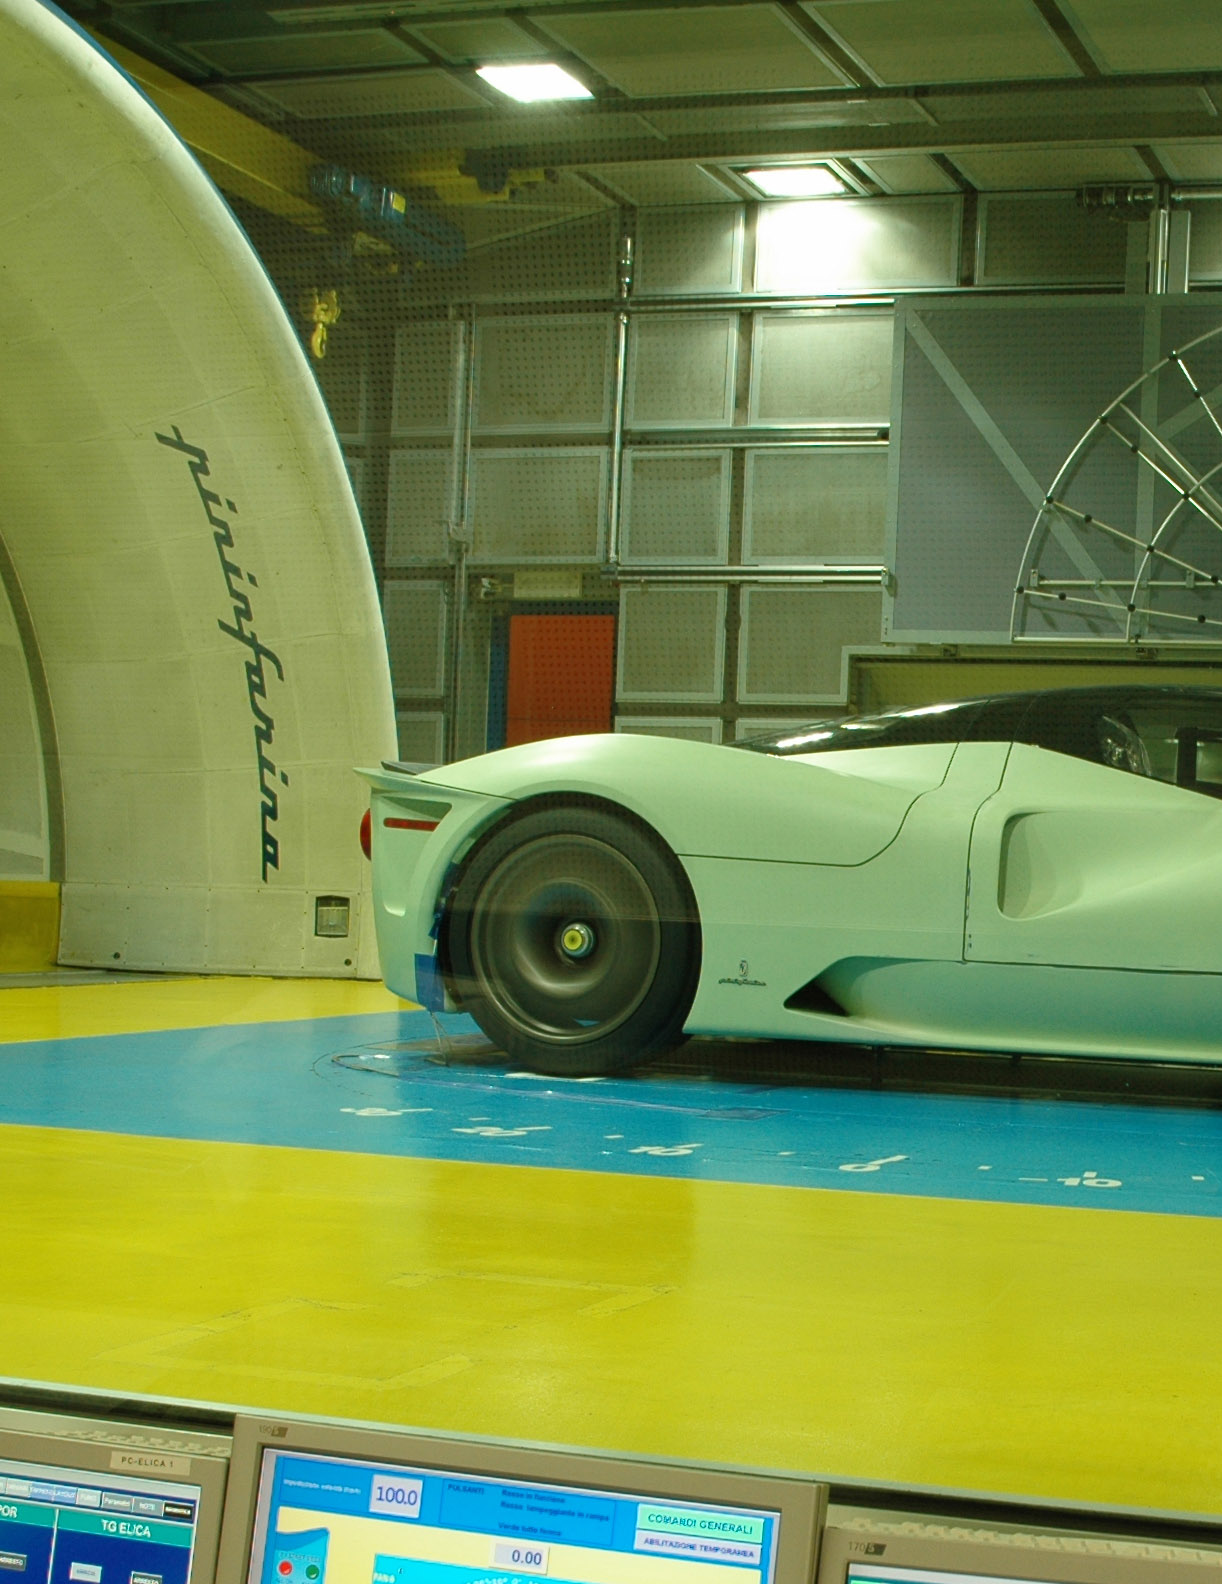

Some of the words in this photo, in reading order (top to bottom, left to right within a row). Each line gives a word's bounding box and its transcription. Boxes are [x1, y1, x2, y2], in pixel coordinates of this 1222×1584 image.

[154, 424, 291, 883] pininfarina
[121, 1456, 166, 1467] PC-ELICA
[375, 1486, 418, 1506] 100.0
[101, 1519, 116, 1532] TG
[118, 1522, 151, 1538] ELICA
[647, 1513, 697, 1527] COMANDI
[699, 1519, 753, 1535] GENERALI
[511, 1549, 543, 1566] 0.00
[643, 1536, 698, 1551] ABILITAZIONE
[699, 1543, 755, 1559] TEMPORANEA
